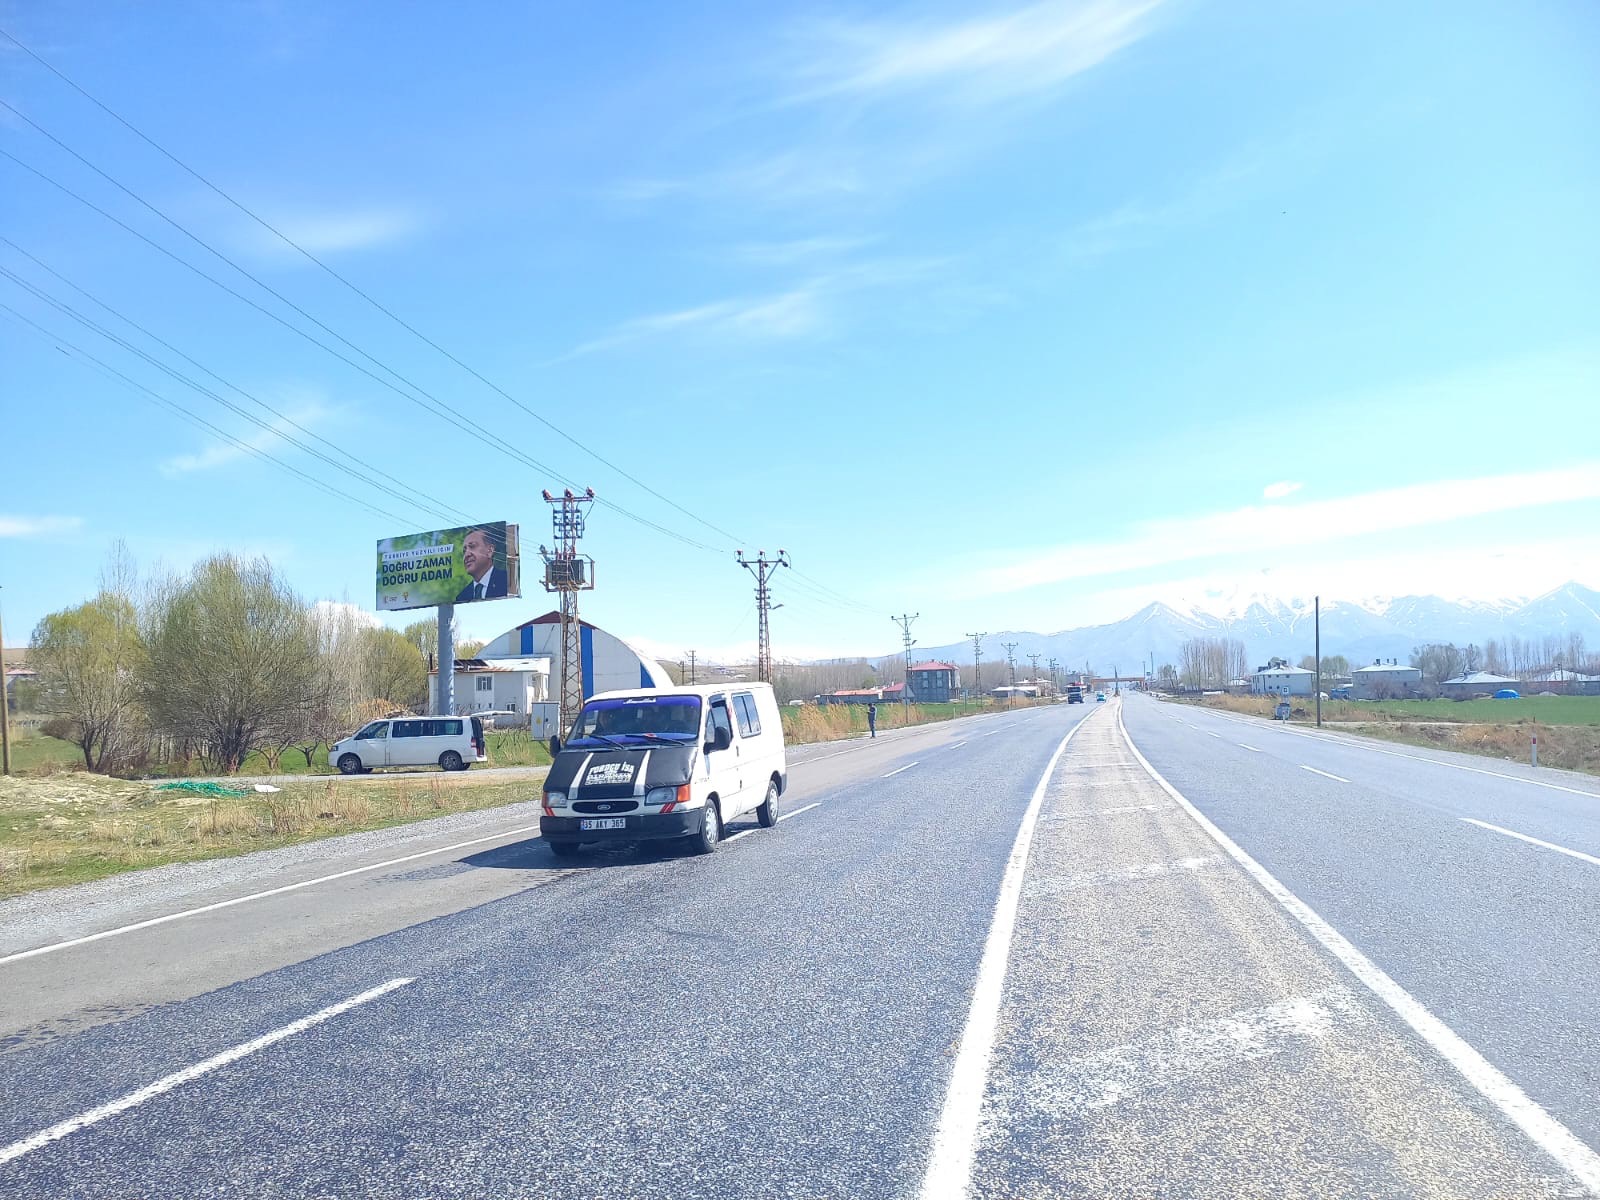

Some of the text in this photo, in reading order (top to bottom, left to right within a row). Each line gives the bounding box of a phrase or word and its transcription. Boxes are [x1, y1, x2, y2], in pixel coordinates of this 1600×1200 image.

[382, 556, 452, 574] DOĞRU ZAMAN
[382, 568, 453, 586] DOĞRU ADAM
